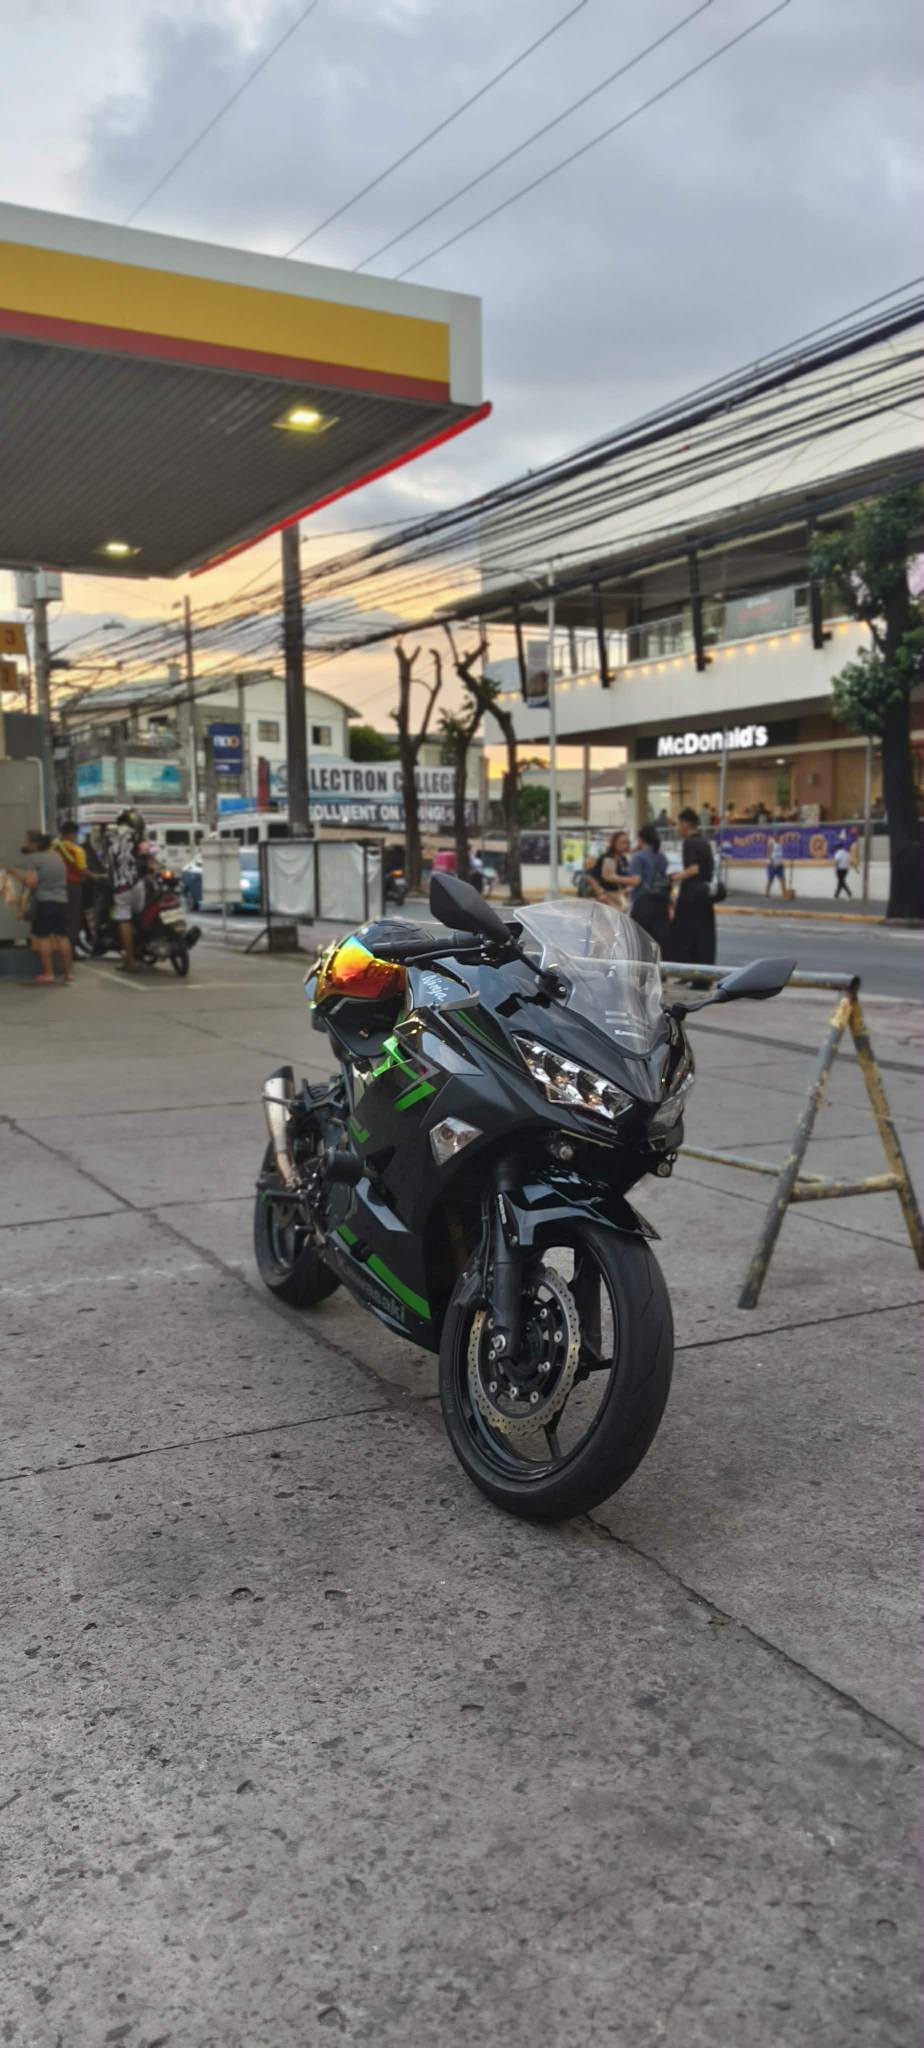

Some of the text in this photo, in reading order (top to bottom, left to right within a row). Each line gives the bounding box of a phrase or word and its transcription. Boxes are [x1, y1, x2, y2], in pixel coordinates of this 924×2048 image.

[657, 725, 768, 757] McDonald's
[309, 767, 456, 794] LECTRON CLLEG
[379, 804, 400, 821] ON
[421, 974, 449, 1002] Ninja
